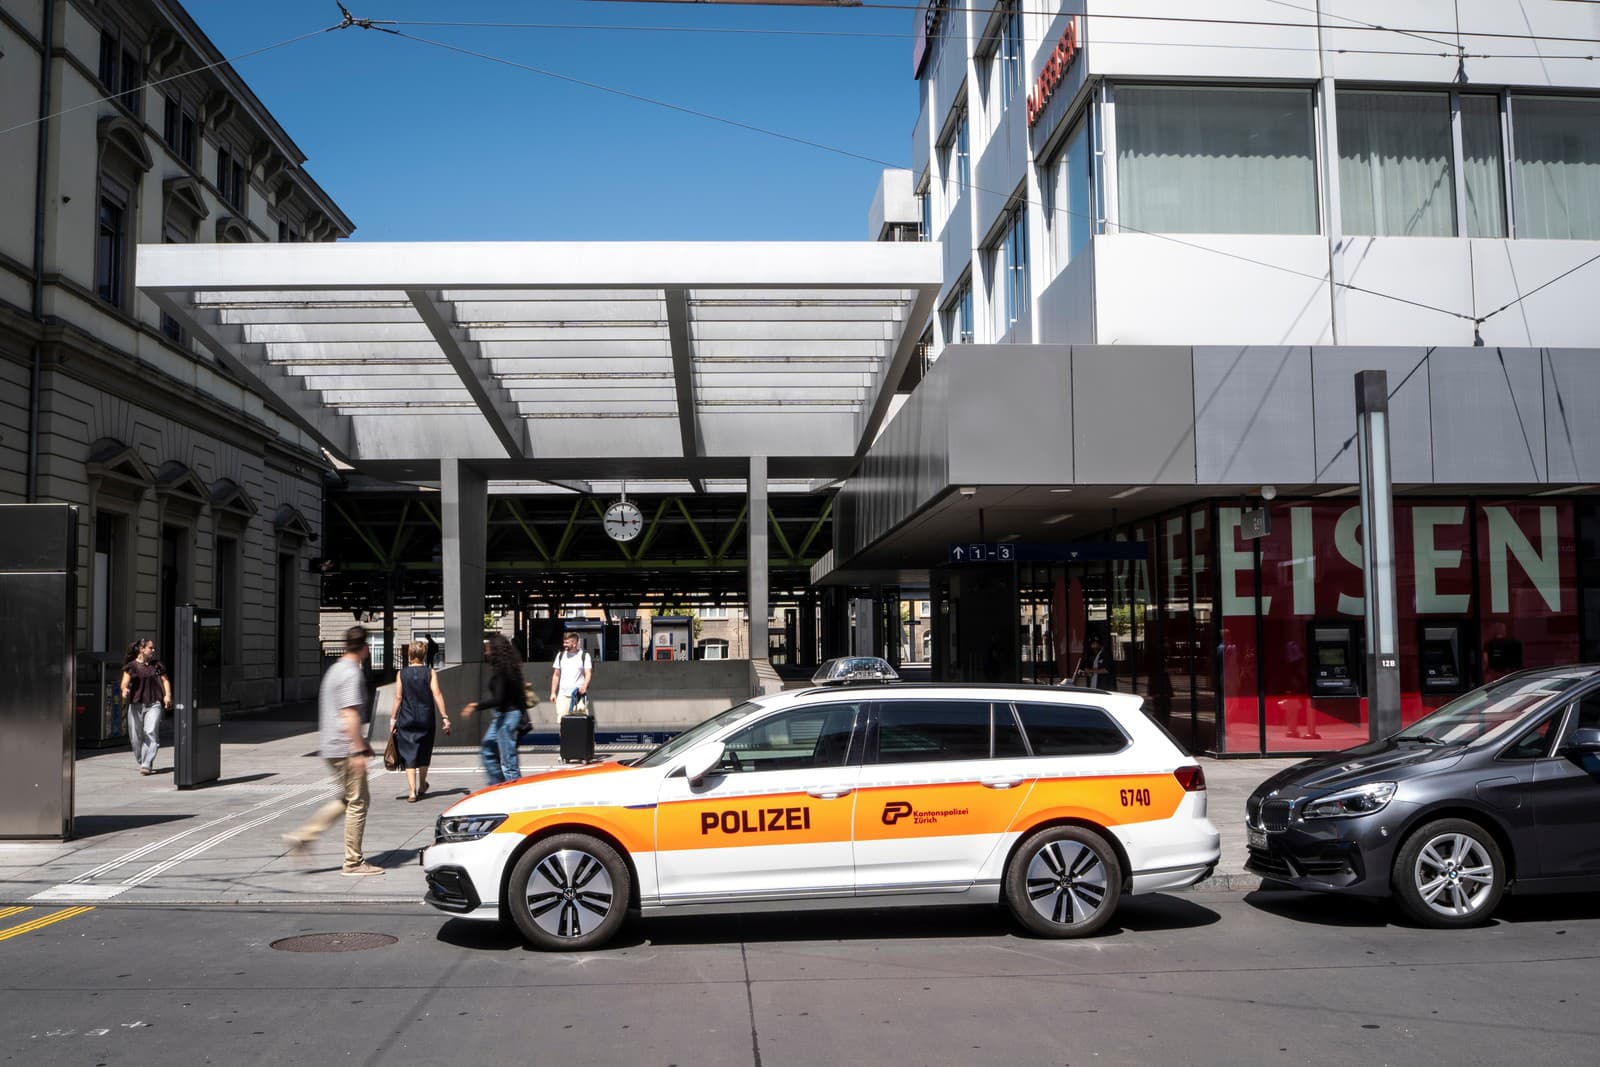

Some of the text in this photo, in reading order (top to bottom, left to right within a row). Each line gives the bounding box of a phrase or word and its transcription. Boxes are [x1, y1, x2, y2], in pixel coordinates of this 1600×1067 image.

[1120, 788, 1151, 807] 6740
[913, 807, 969, 818] Kantonspolizei
[701, 806, 811, 835] POLIZEI
[913, 816, 938, 825] Zürich
